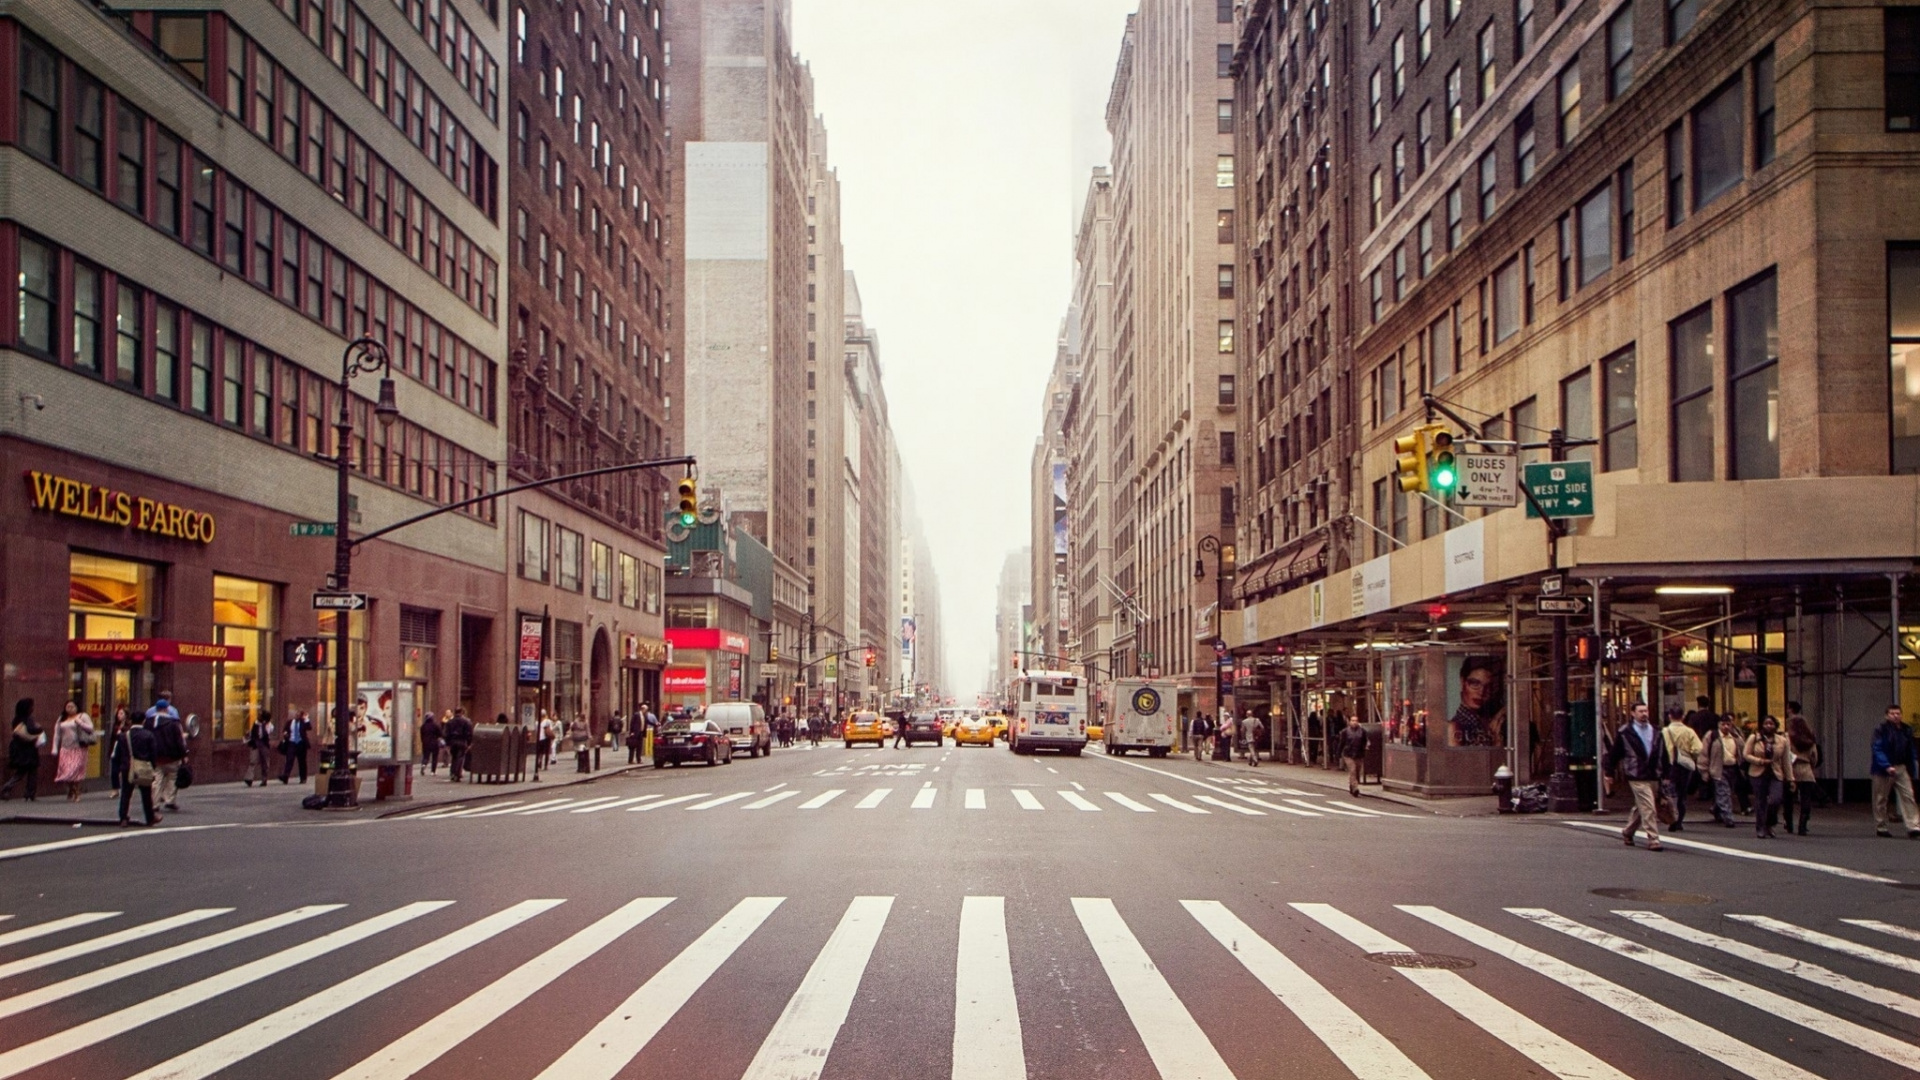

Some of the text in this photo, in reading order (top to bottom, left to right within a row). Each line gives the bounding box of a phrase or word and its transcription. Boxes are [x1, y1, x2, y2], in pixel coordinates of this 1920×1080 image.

[1467, 458, 1506, 470] BUSES
[1471, 472, 1502, 483] ONLY
[1533, 483, 1588, 496] WEST SIDE
[31, 470, 216, 544] WELLS FARGO
[300, 524, 309, 534] W
[310, 524, 324, 534] 39
[320, 598, 335, 606] ONE
[1545, 601, 1559, 609] ONE
[77, 643, 149, 652] WELLS FARGO
[178, 643, 228, 658] WELLS FARGO
[834, 763, 927, 771] LANE
